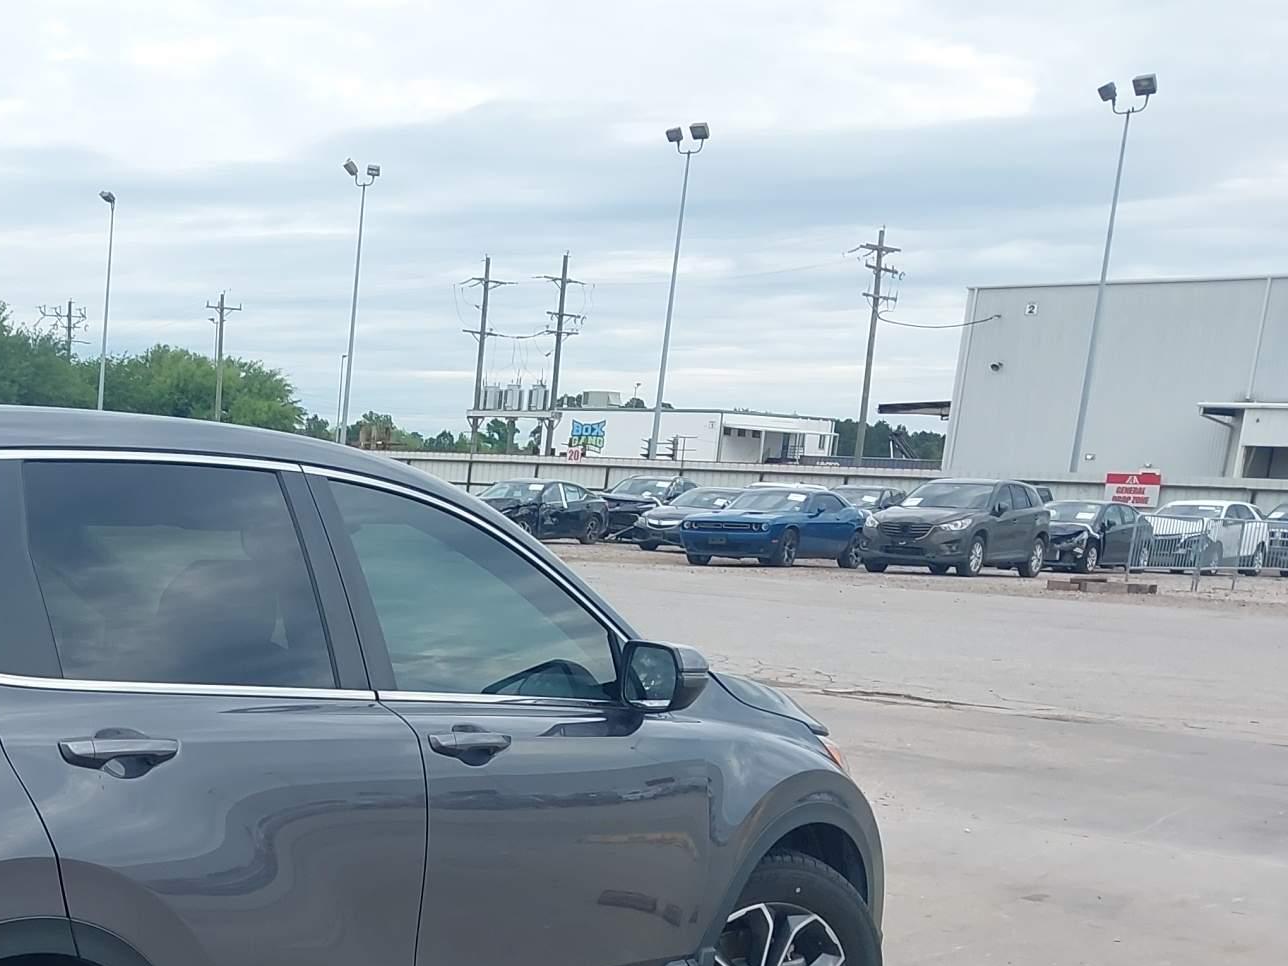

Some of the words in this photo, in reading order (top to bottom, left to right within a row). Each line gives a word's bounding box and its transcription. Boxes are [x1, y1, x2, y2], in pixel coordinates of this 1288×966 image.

[571, 419, 606, 437] BOX
[568, 449, 580, 461] 20
[1115, 486, 1146, 495] GENERAL
